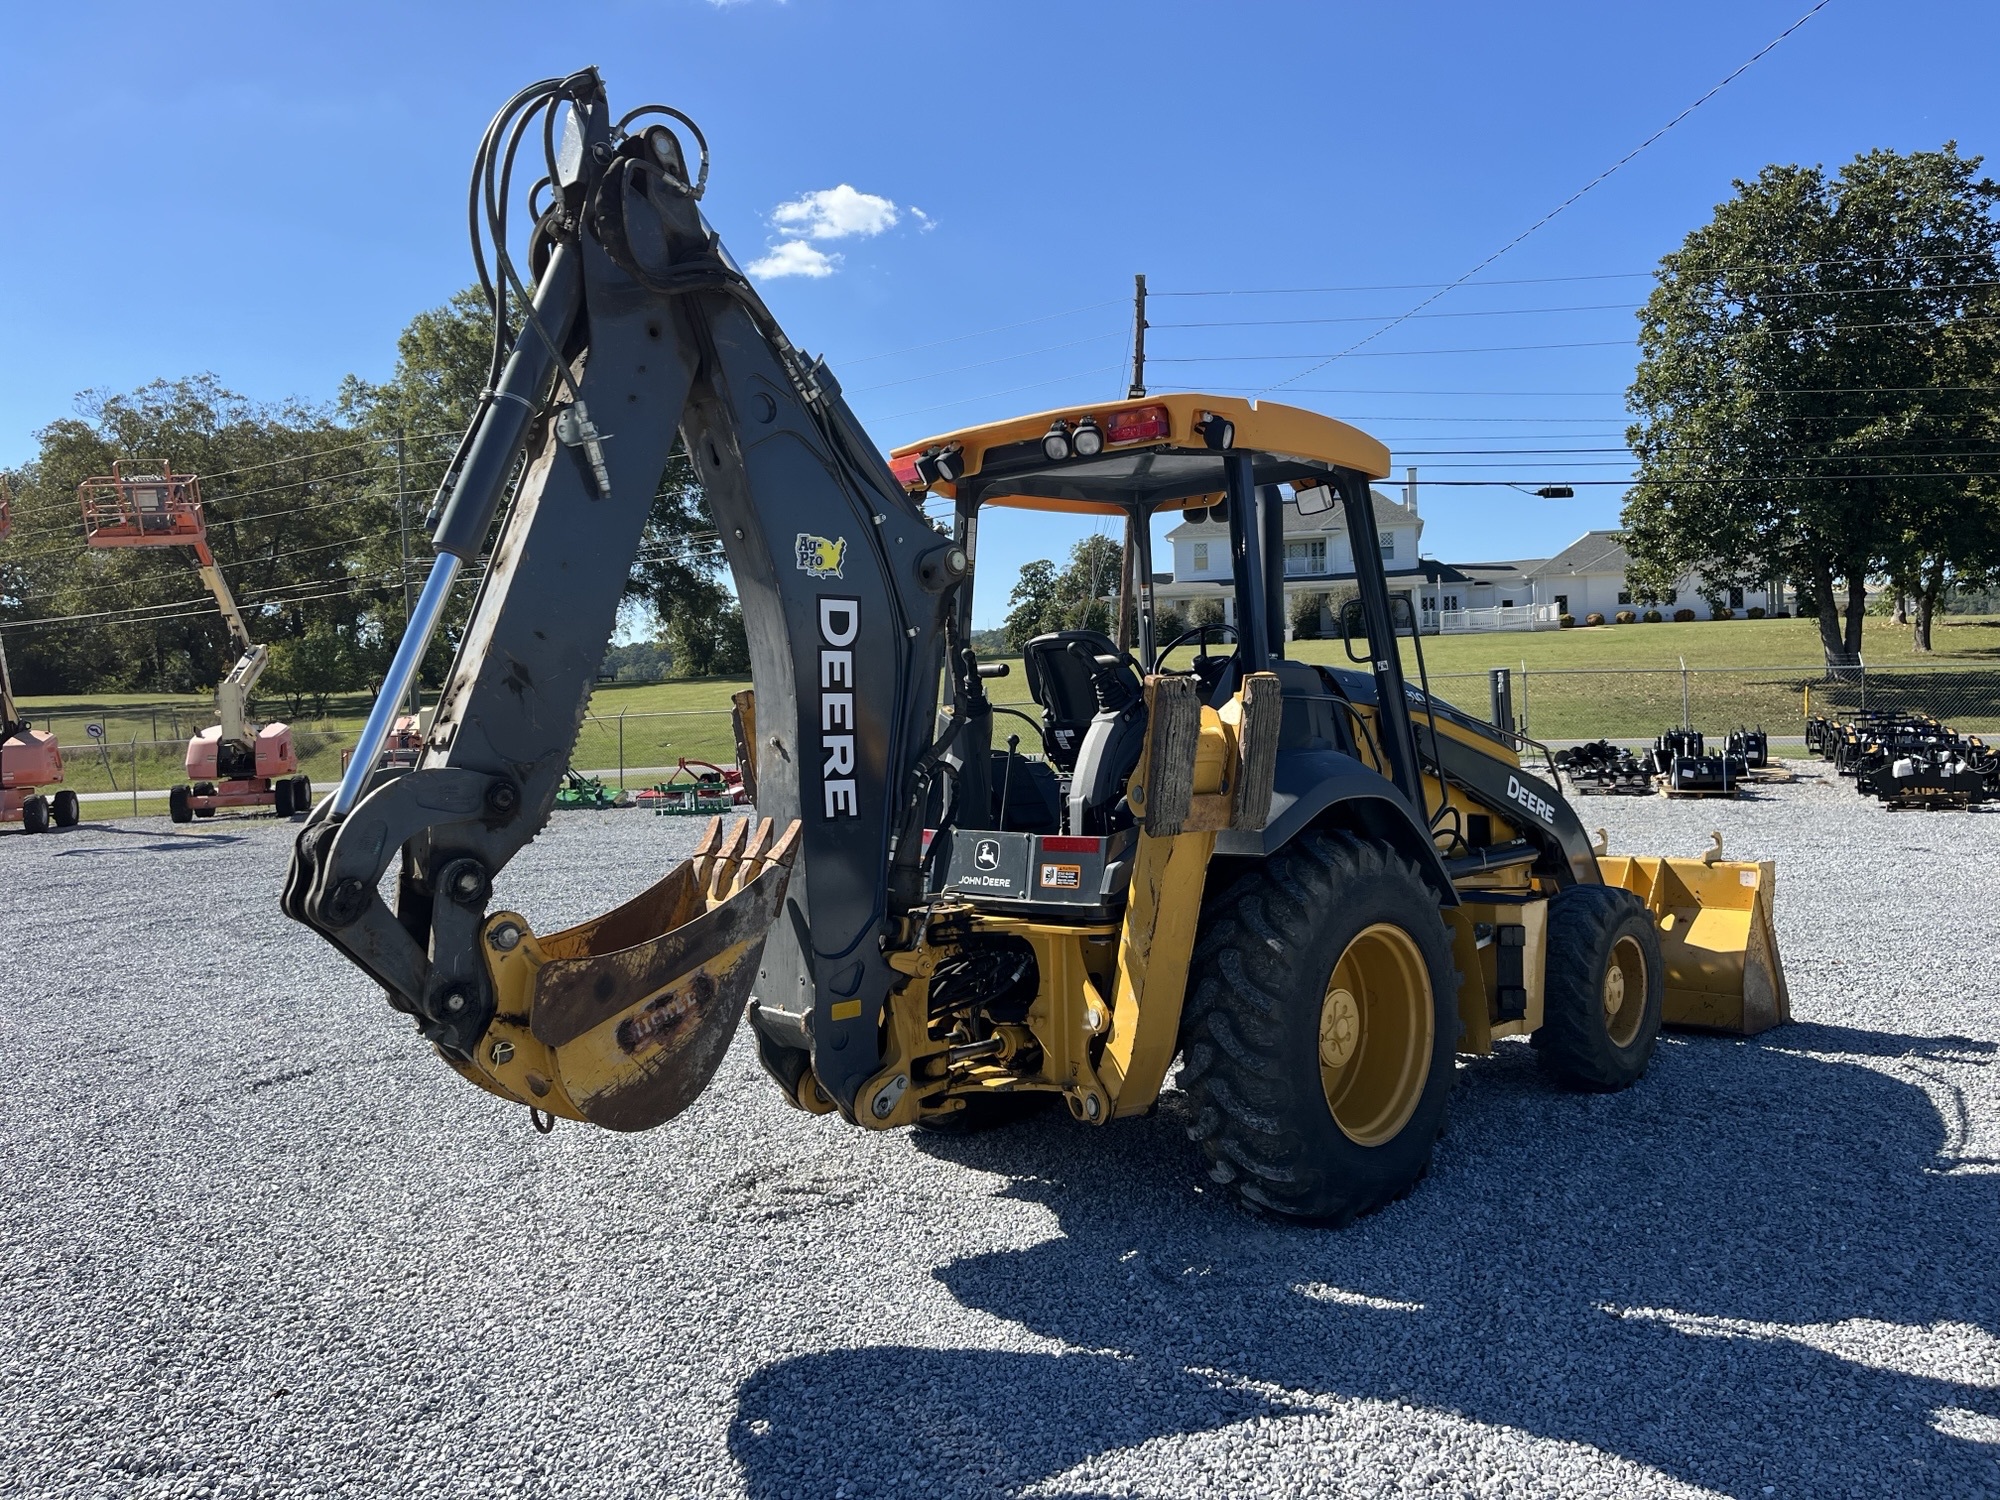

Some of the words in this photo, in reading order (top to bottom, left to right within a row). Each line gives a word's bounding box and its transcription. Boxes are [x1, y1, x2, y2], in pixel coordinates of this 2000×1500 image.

[800, 552, 823, 566] Pro
[820, 599, 858, 818] DEERE
[1506, 775, 1555, 824] DEERE
[958, 876, 981, 885] JOHN
[982, 876, 1011, 887] DEERE
